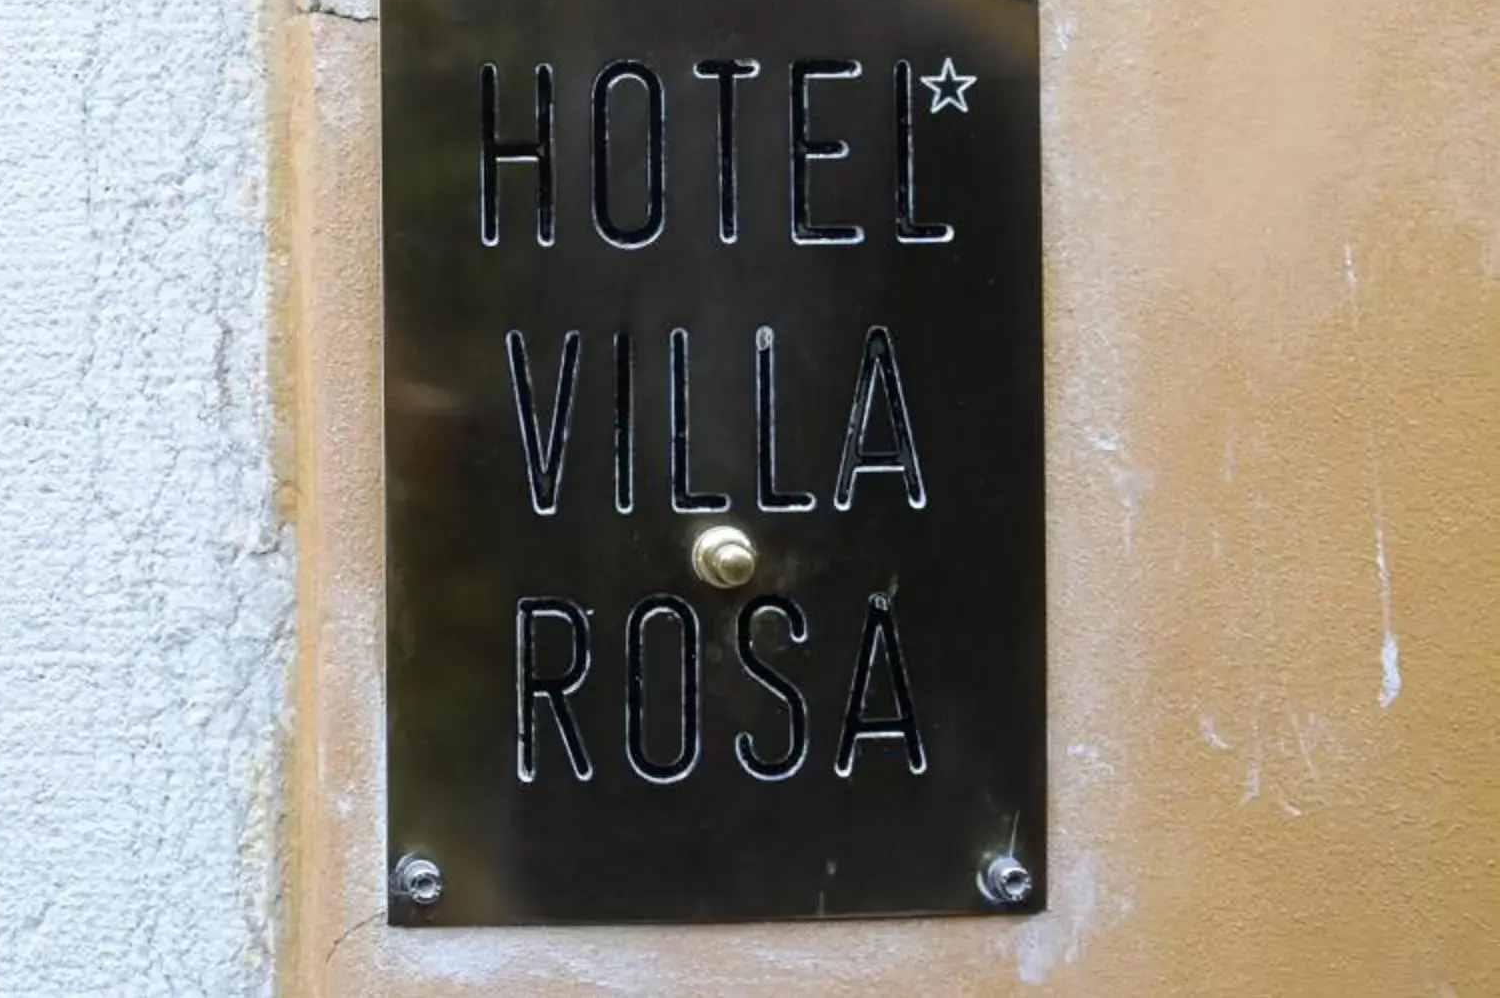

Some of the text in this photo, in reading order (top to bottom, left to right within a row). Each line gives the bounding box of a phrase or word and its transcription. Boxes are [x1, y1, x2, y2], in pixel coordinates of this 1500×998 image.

[480, 58, 955, 248] HOTEL
[505, 325, 928, 514] VILLA
[517, 592, 928, 782] ROSA
